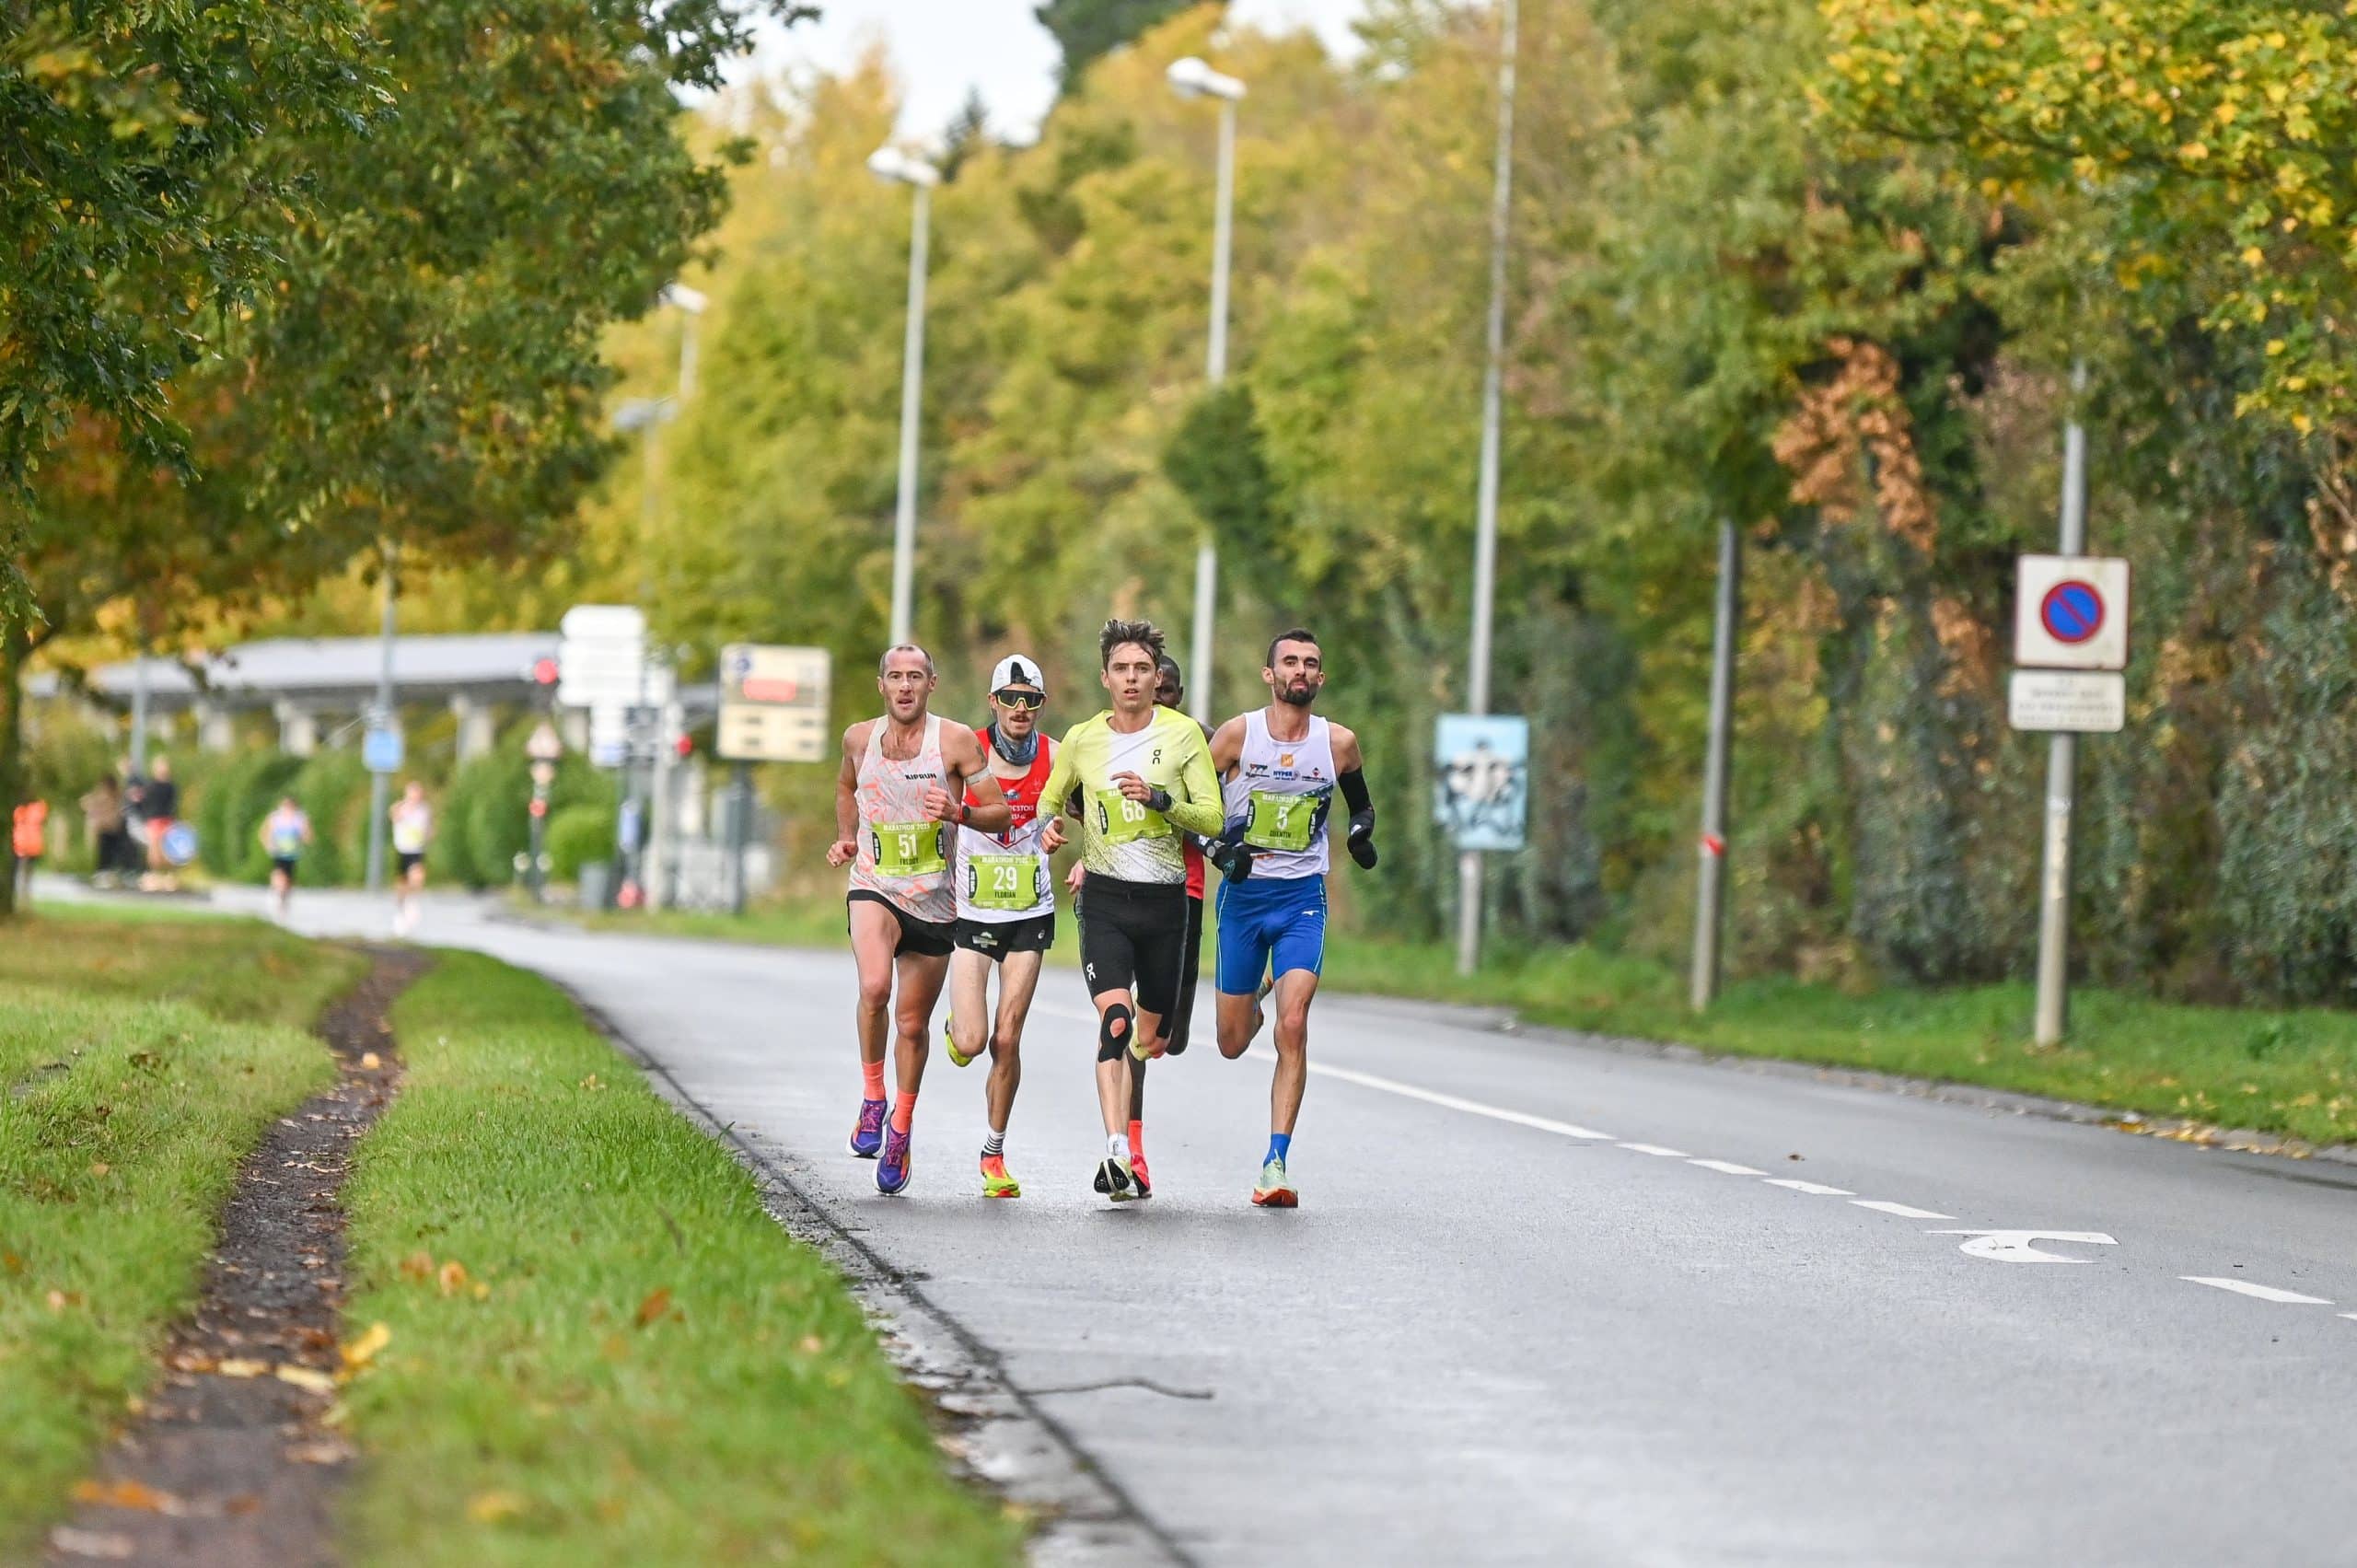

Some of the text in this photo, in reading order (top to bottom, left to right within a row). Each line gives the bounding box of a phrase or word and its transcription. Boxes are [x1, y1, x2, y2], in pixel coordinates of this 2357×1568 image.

[1262, 794, 1295, 804] MARATHON
[1121, 797, 1146, 823] 68
[1276, 806, 1289, 830] 5
[884, 823, 915, 831] MARATHON
[1269, 830, 1292, 839] QUENTIN
[898, 833, 918, 858] 51
[981, 855, 1015, 864] MARATHON
[993, 865, 1017, 891] 29
[994, 890, 1016, 899] FLORIAN
